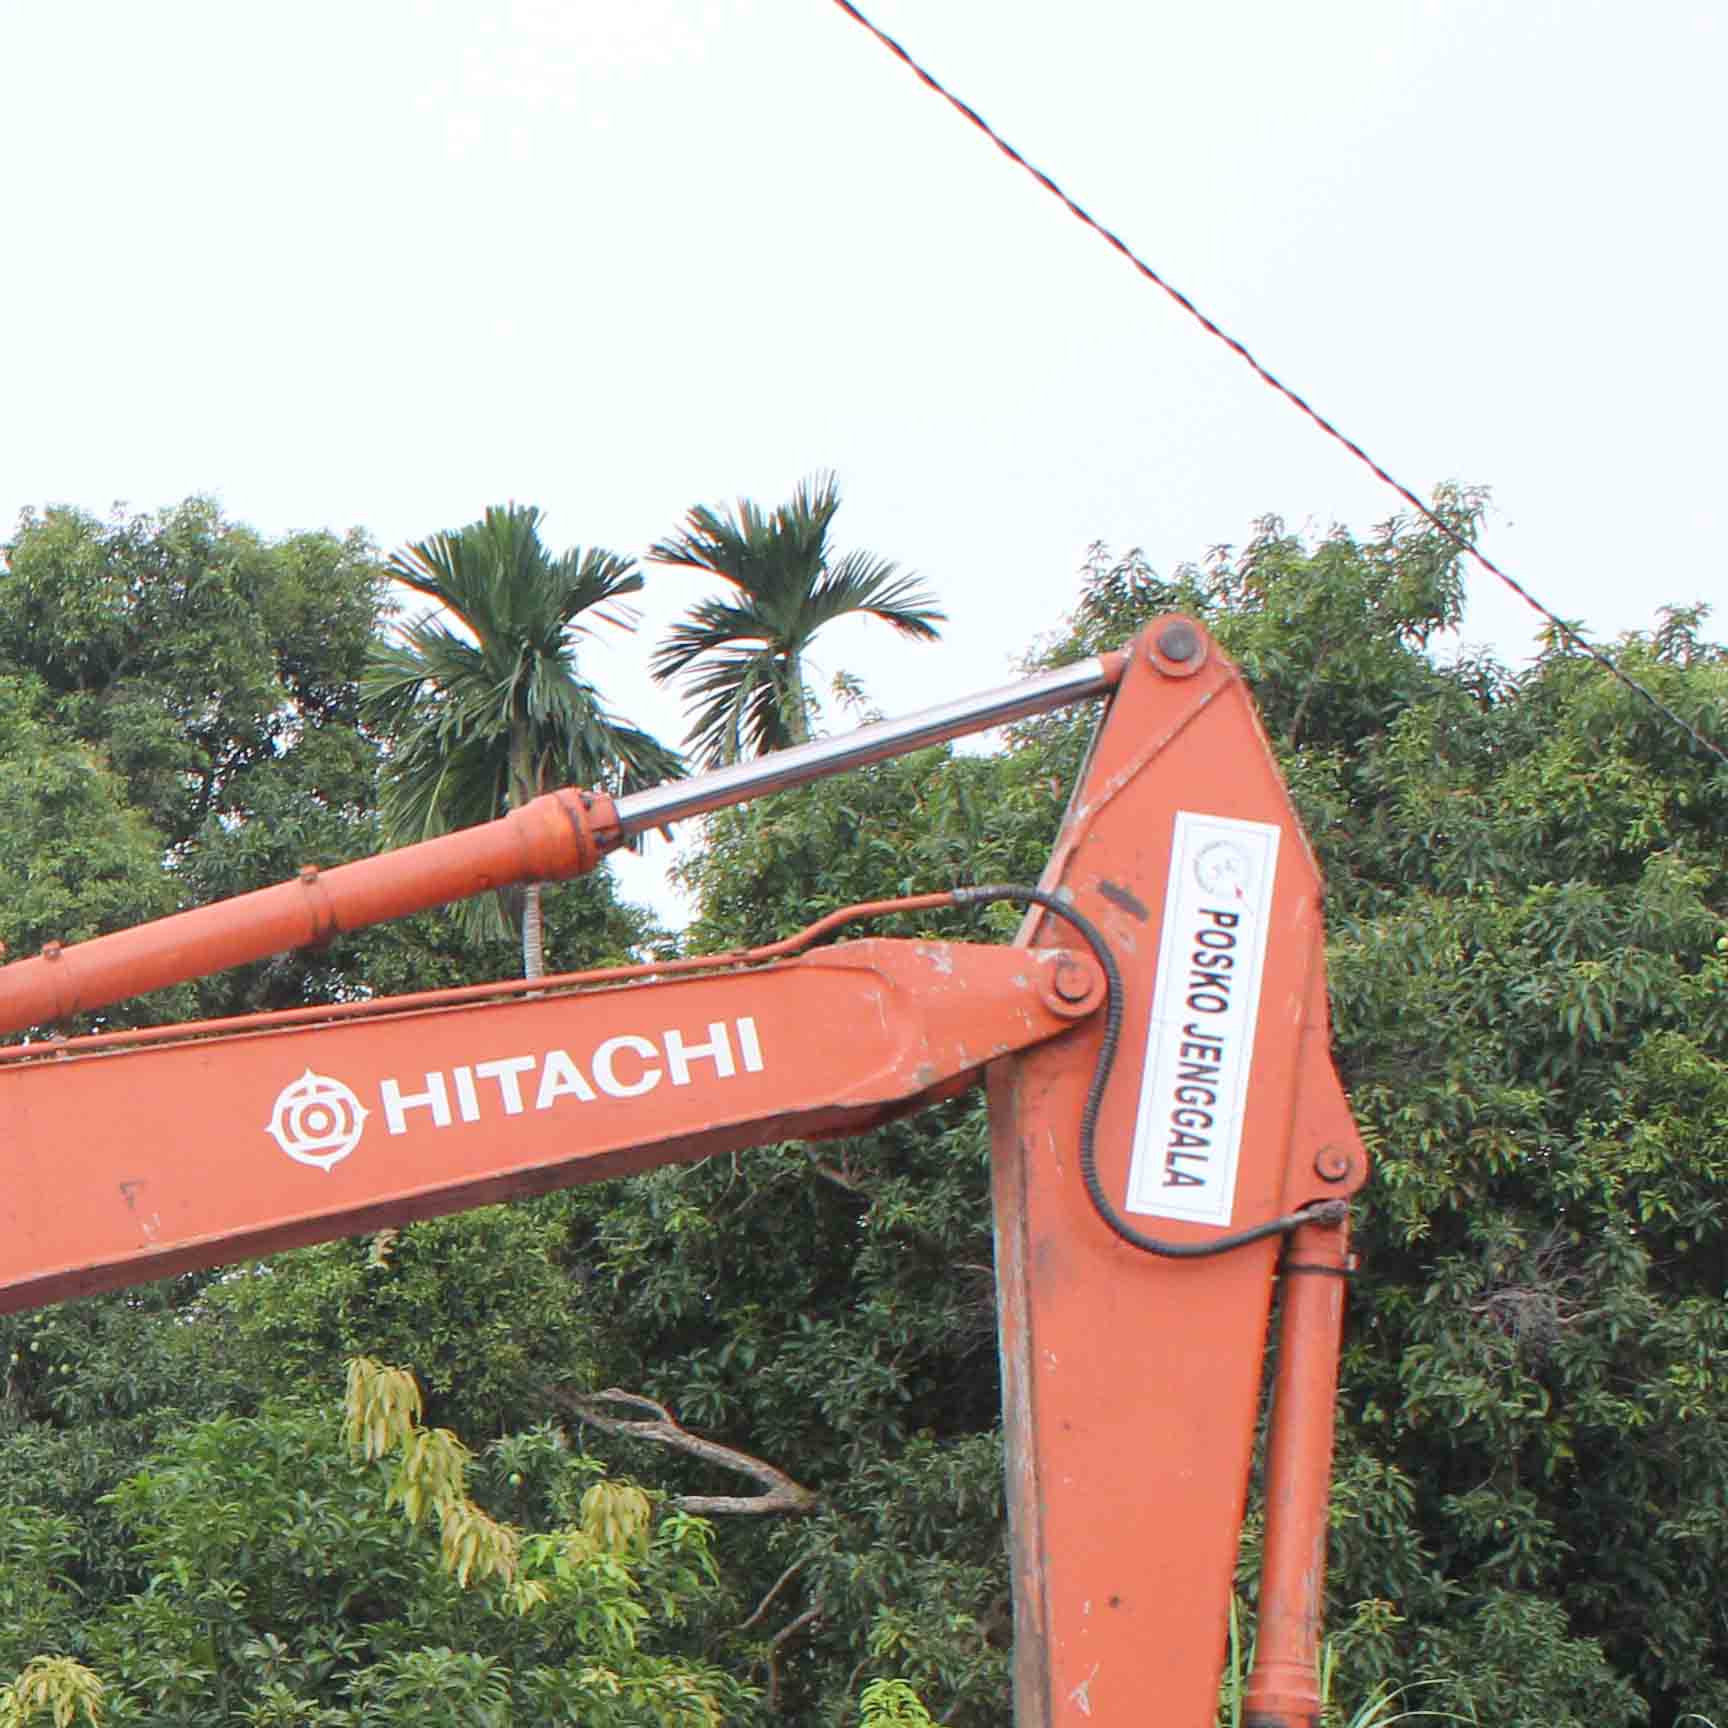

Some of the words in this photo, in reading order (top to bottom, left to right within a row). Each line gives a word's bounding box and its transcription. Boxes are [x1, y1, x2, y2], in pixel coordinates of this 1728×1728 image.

[1185, 908, 1241, 1015] POSKO
[380, 1017, 764, 1136] HITACHI
[1161, 1021, 1225, 1188] JENGGALA
